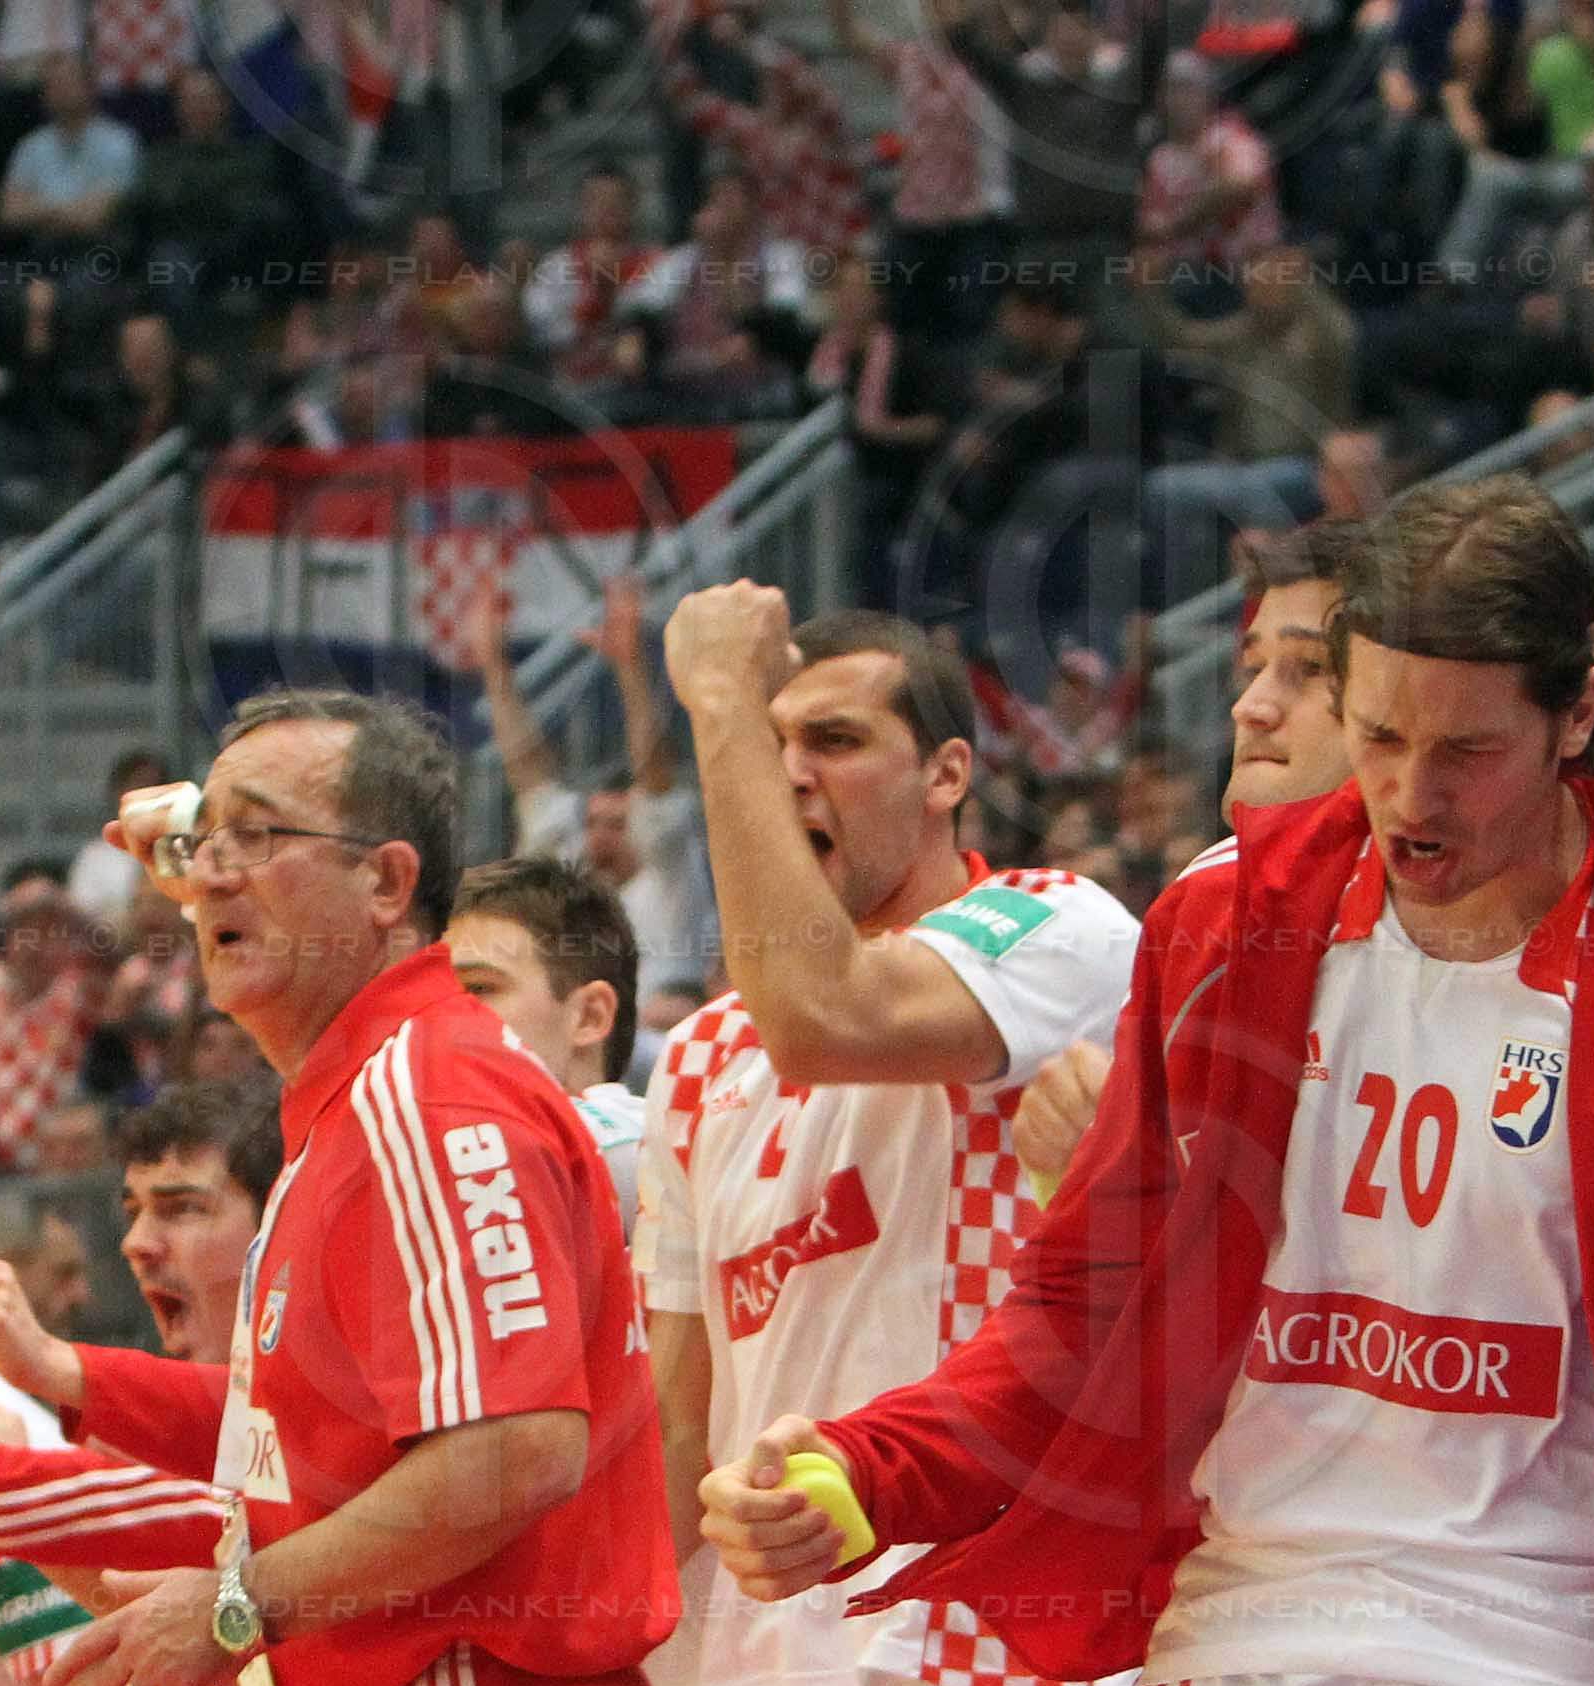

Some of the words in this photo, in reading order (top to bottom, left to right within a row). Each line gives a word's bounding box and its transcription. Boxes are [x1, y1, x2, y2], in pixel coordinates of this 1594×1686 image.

[1501, 1043, 1565, 1074] HRS
[1341, 1071, 1459, 1229] 20
[443, 1122, 549, 1341] nexe
[1253, 1306, 1511, 1399] AGROKOR
